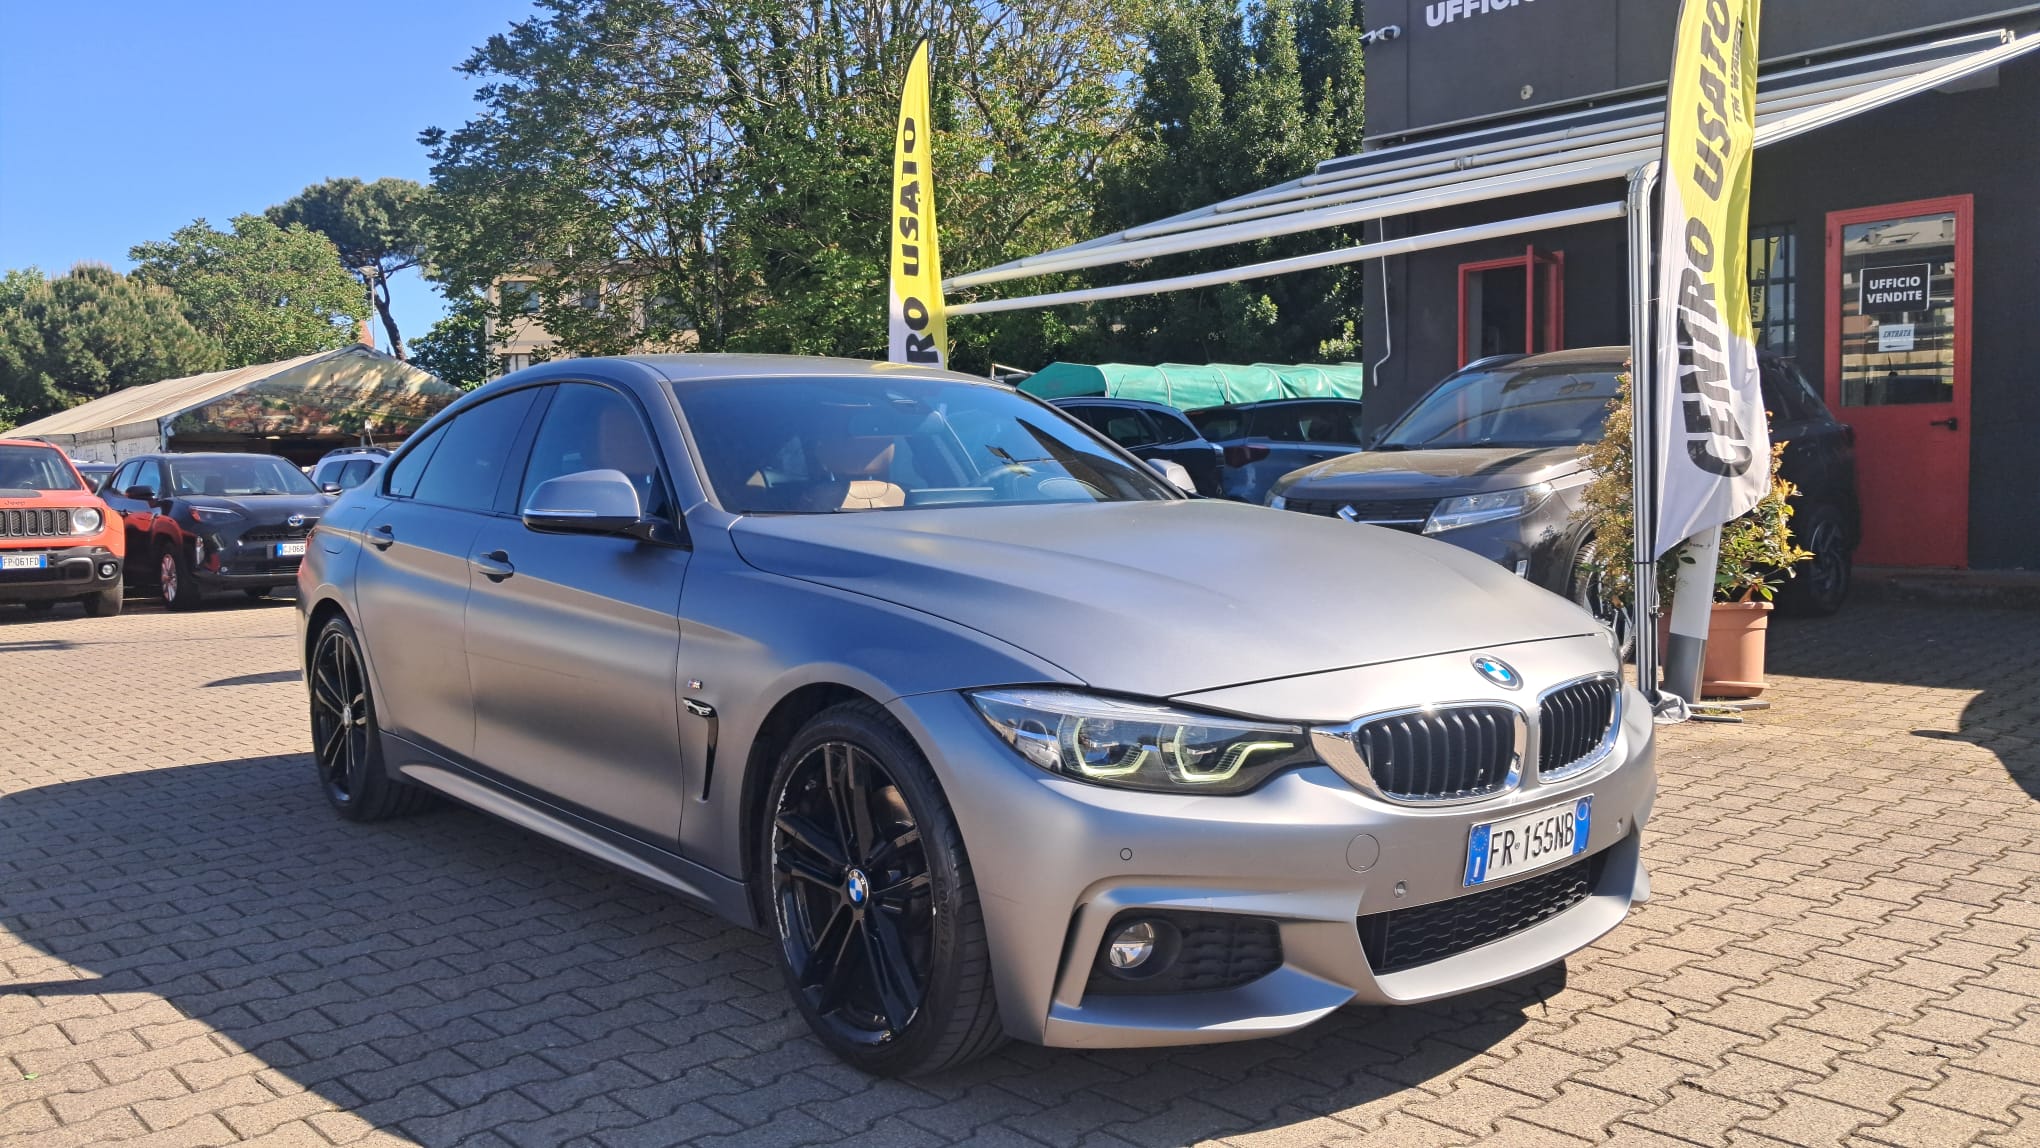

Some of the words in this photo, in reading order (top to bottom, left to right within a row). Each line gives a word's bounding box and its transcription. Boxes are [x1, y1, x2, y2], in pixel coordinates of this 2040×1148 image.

[1426, 0, 1534, 27] UFFI
[1693, 0, 1731, 201] USATO
[900, 117, 920, 276] USATO
[1869, 276, 1921, 290] UFFICIO
[1866, 290, 1923, 304] VENDITE
[1677, 217, 1752, 477] CENTRO
[1882, 329, 1912, 338] ENTRATA
